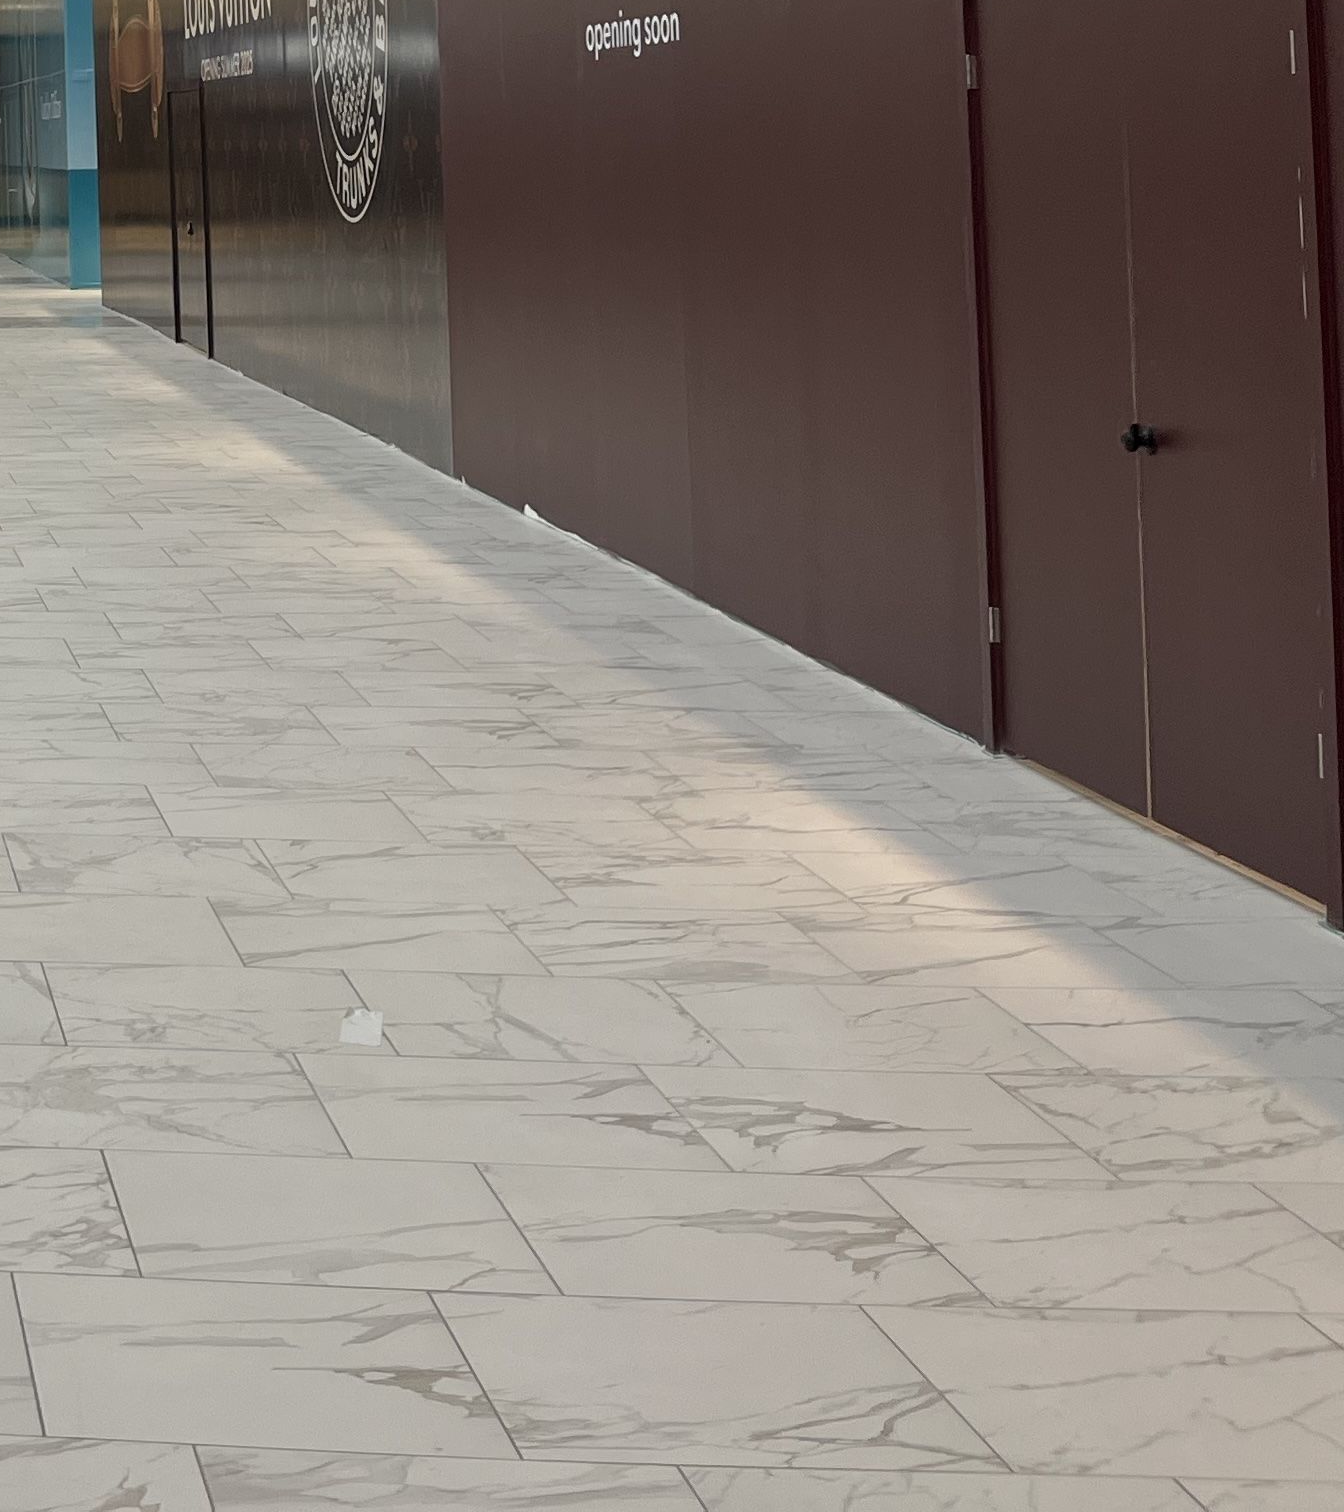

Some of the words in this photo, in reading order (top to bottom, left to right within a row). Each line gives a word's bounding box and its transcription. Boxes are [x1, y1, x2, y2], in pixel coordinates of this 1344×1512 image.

[585, 9, 642, 61] opening
[644, 11, 680, 45] soon
[335, 116, 379, 209] TRUNKS
